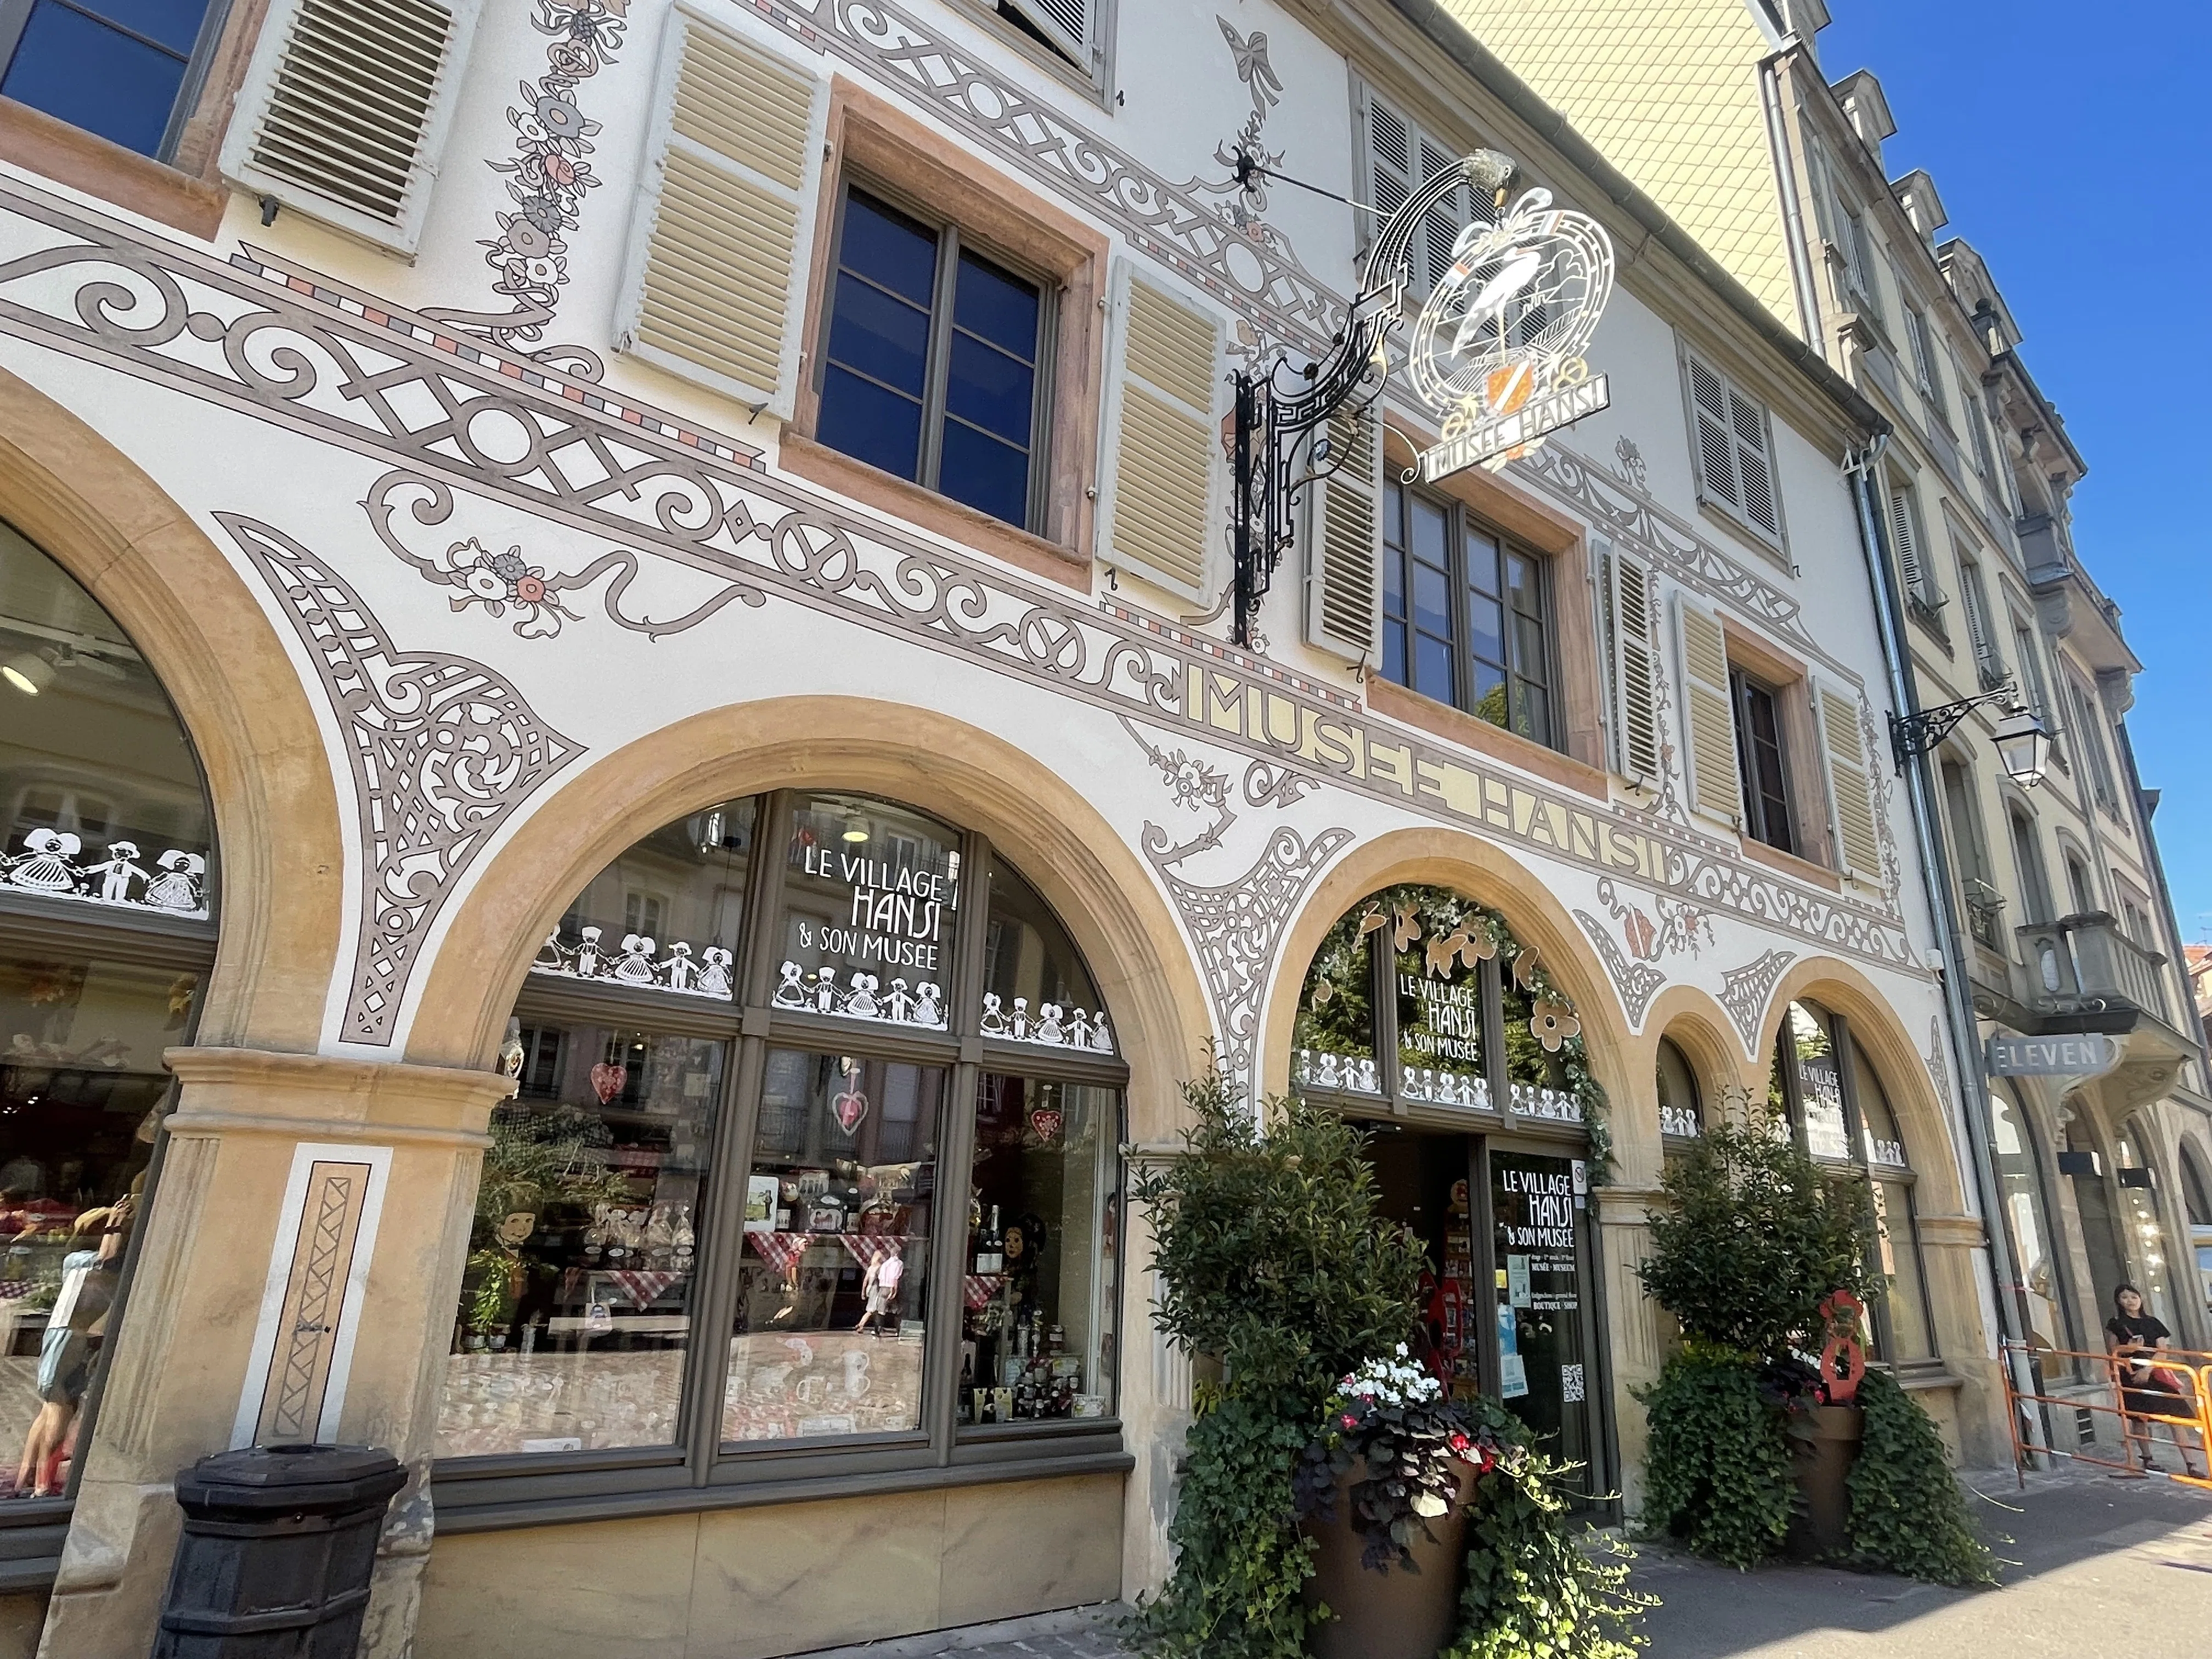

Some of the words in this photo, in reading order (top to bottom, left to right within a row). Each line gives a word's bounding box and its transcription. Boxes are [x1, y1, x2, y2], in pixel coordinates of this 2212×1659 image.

[1435, 422, 1505, 475] MUSEE
[1519, 379, 1604, 440] HANSI
[1201, 666, 1447, 809] MUSEE
[1480, 772, 1656, 881] HANSI
[805, 845, 833, 878] LE
[840, 853, 943, 901] VILLAGE
[851, 885, 940, 941] HANSI
[798, 922, 812, 948] &
[820, 926, 857, 956] SON
[1400, 974, 1416, 997] LE
[1418, 977, 1475, 1009] VILLAGE
[1429, 1001, 1476, 1040] HANSI
[1404, 1030, 1412, 1050] &
[1414, 1032, 1435, 1054] SON
[1996, 1041, 2098, 1068] ELEVEN
[1799, 1064, 1808, 1081] LE
[1808, 1066, 1839, 1088] VILLAGE
[1503, 1170, 1518, 1192] LE
[1519, 1171, 1571, 1196] VILLAGE
[1529, 1194, 1573, 1228] HANSI
[1517, 1227, 1536, 1246] SON
